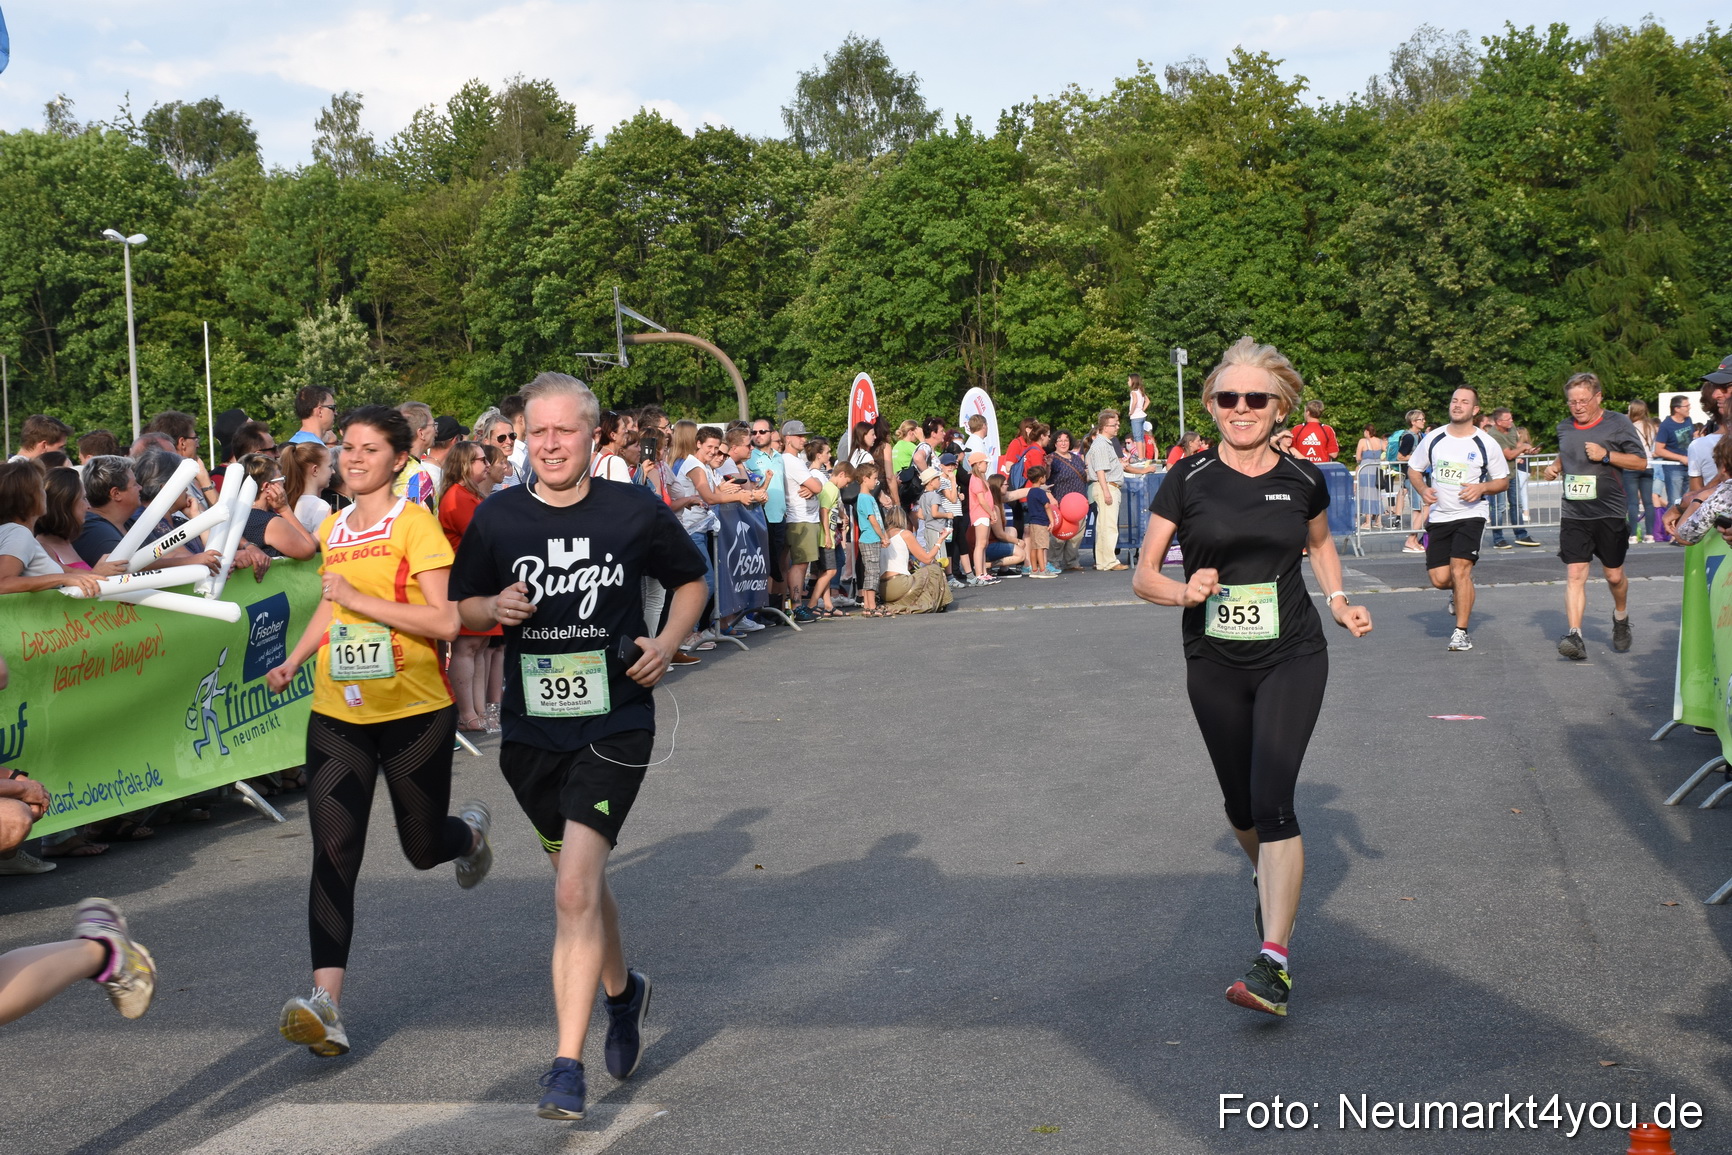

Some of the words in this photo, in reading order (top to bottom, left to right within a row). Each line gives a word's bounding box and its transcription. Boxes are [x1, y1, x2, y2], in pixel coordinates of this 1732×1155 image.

[1440, 469, 1462, 479] 1874
[1265, 493, 1291, 501] THERESIA
[1567, 484, 1590, 493] 1477
[326, 551, 348, 566] MAX
[352, 545, 391, 560] BÖGL
[512, 553, 624, 620] Burgis
[1218, 604, 1260, 625] 953
[21, 611, 91, 661] Gesunde
[84, 602, 141, 635] Firmen
[256, 620, 284, 641] Fischer
[521, 625, 610, 640] Knödelliebe.
[53, 649, 105, 693] laufen
[110, 623, 166, 676] länger!
[336, 642, 381, 665] 1617
[540, 676, 588, 700] 393
[559, 699, 591, 707] Sebastian
[233, 713, 281, 748] neumarkt
